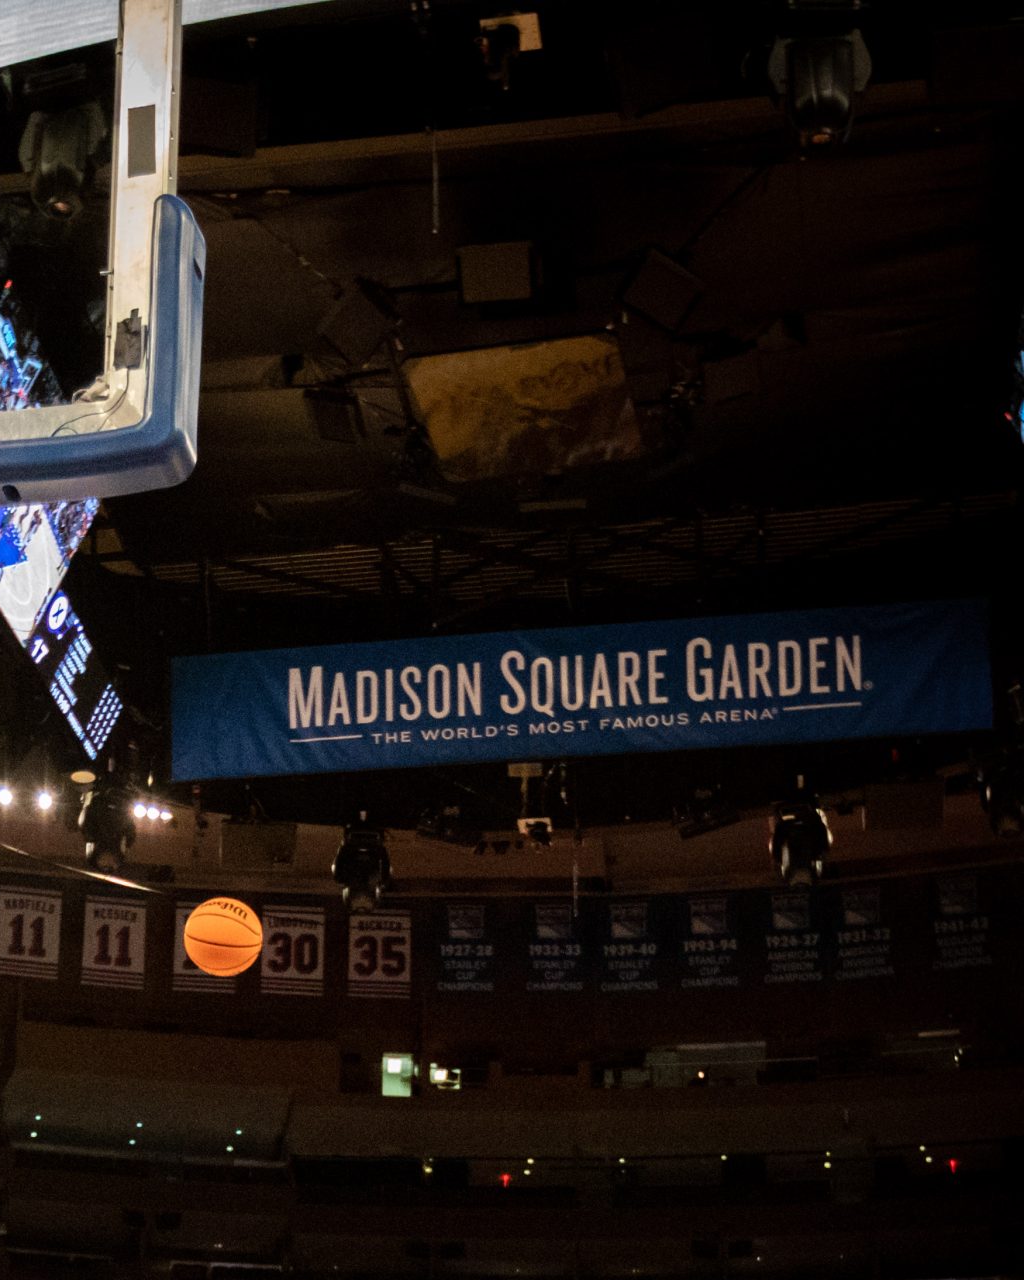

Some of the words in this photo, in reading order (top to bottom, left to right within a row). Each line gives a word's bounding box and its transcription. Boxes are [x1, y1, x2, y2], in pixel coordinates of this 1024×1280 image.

[31, 638, 49, 664] 17
[289, 665, 481, 729] MADISON
[500, 650, 669, 716] SQUARE
[686, 635, 862, 702] GARDEN
[372, 731, 411, 745] THE
[421, 723, 519, 741] WORLD'S
[528, 718, 589, 736] MOST
[599, 711, 689, 731] FAMOUS
[700, 708, 775, 724] ARENA
[8, 914, 46, 958] 11
[93, 923, 132, 967] 11
[267, 932, 318, 974] 30
[353, 936, 407, 977] 35
